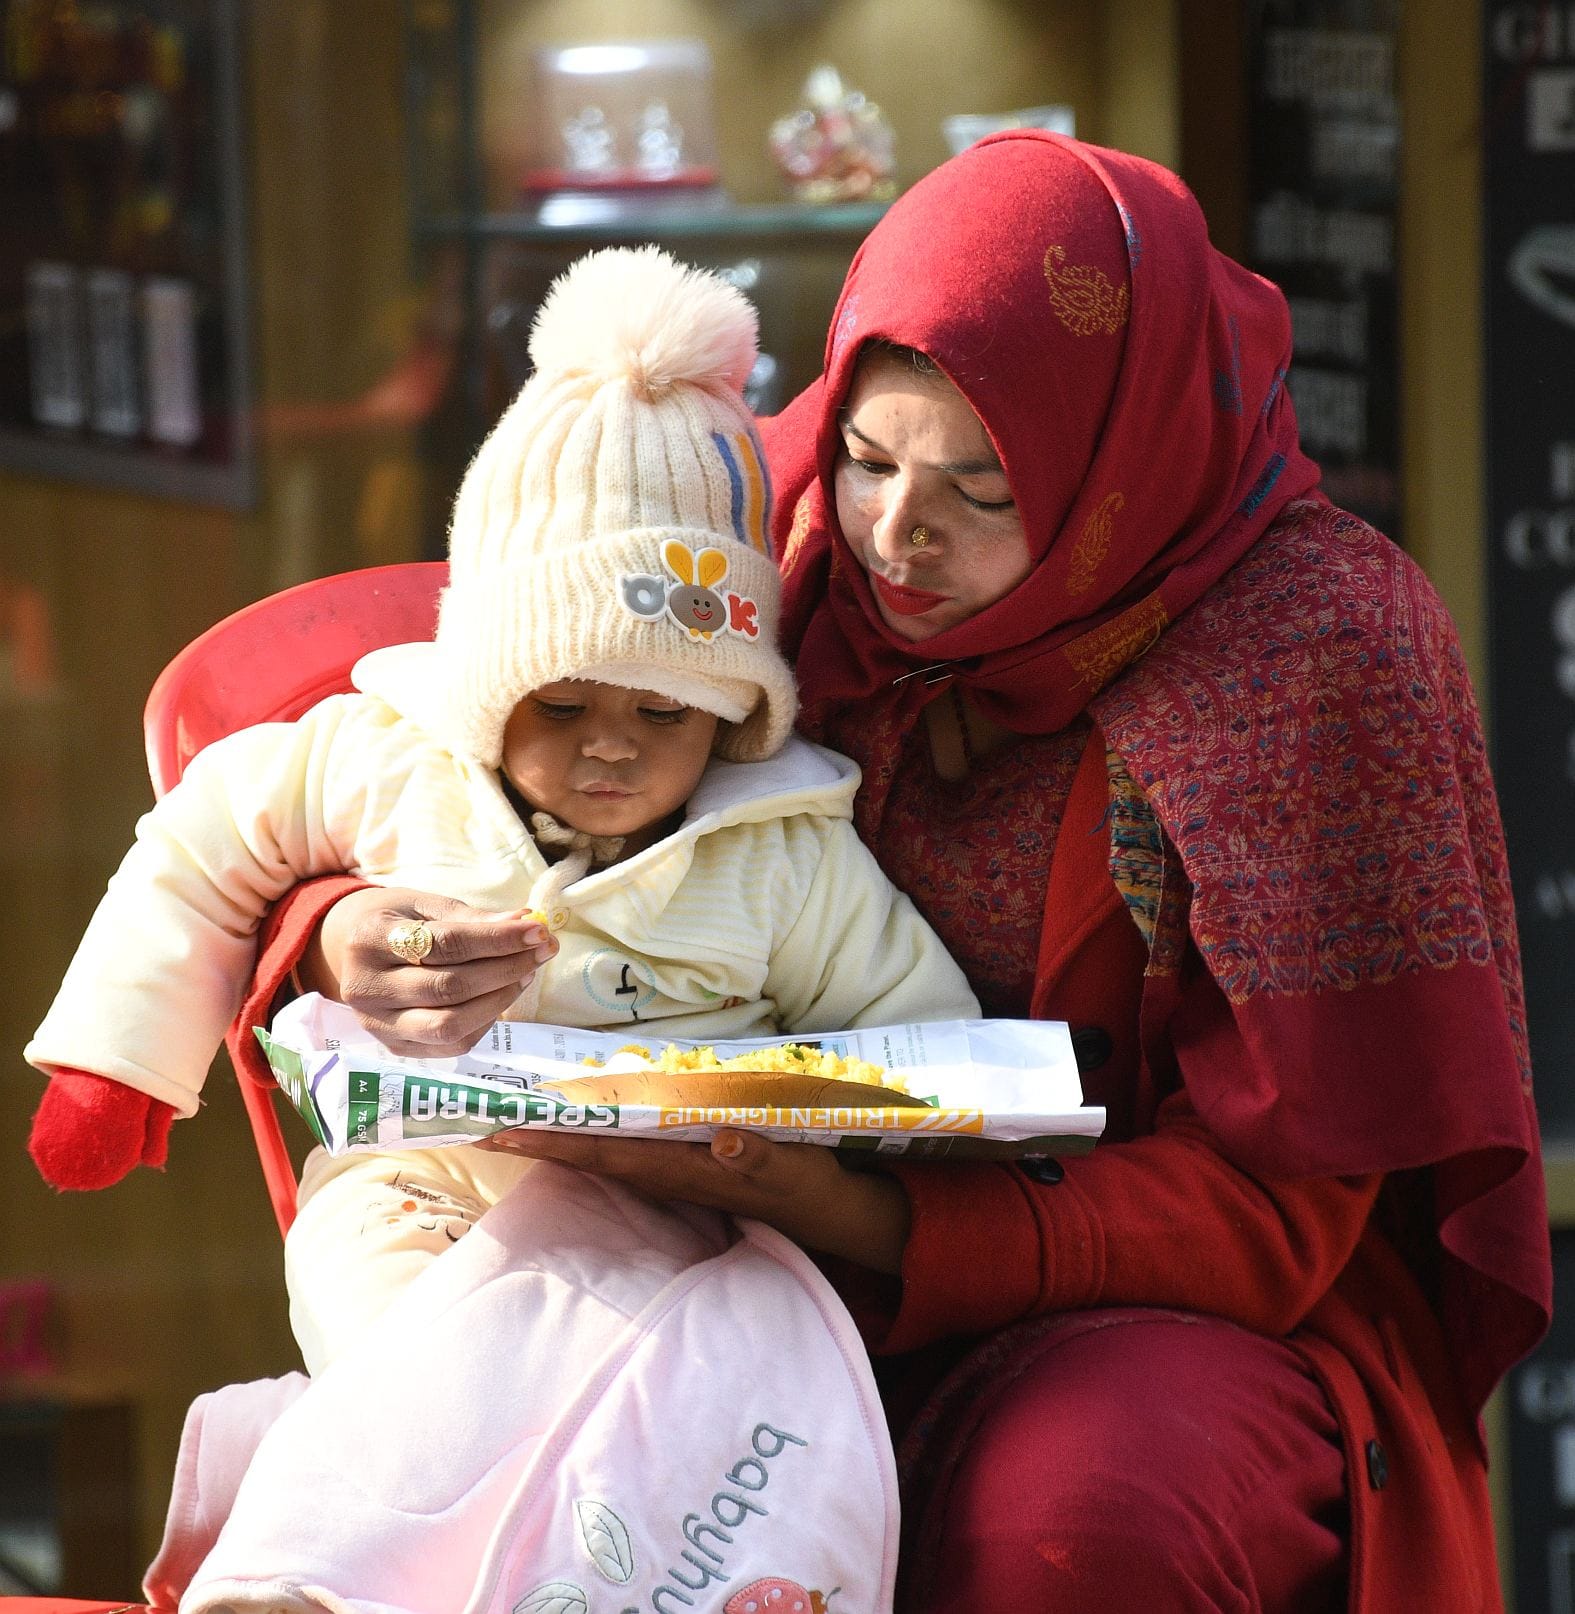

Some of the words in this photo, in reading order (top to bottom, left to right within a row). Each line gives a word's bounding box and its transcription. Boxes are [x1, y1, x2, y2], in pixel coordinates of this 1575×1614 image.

[359, 1079, 368, 1093] A4
[358, 1110, 368, 1123] 75
[409, 1084, 616, 1126] SPECTRA
[619, 1422, 809, 1614] babyhu
